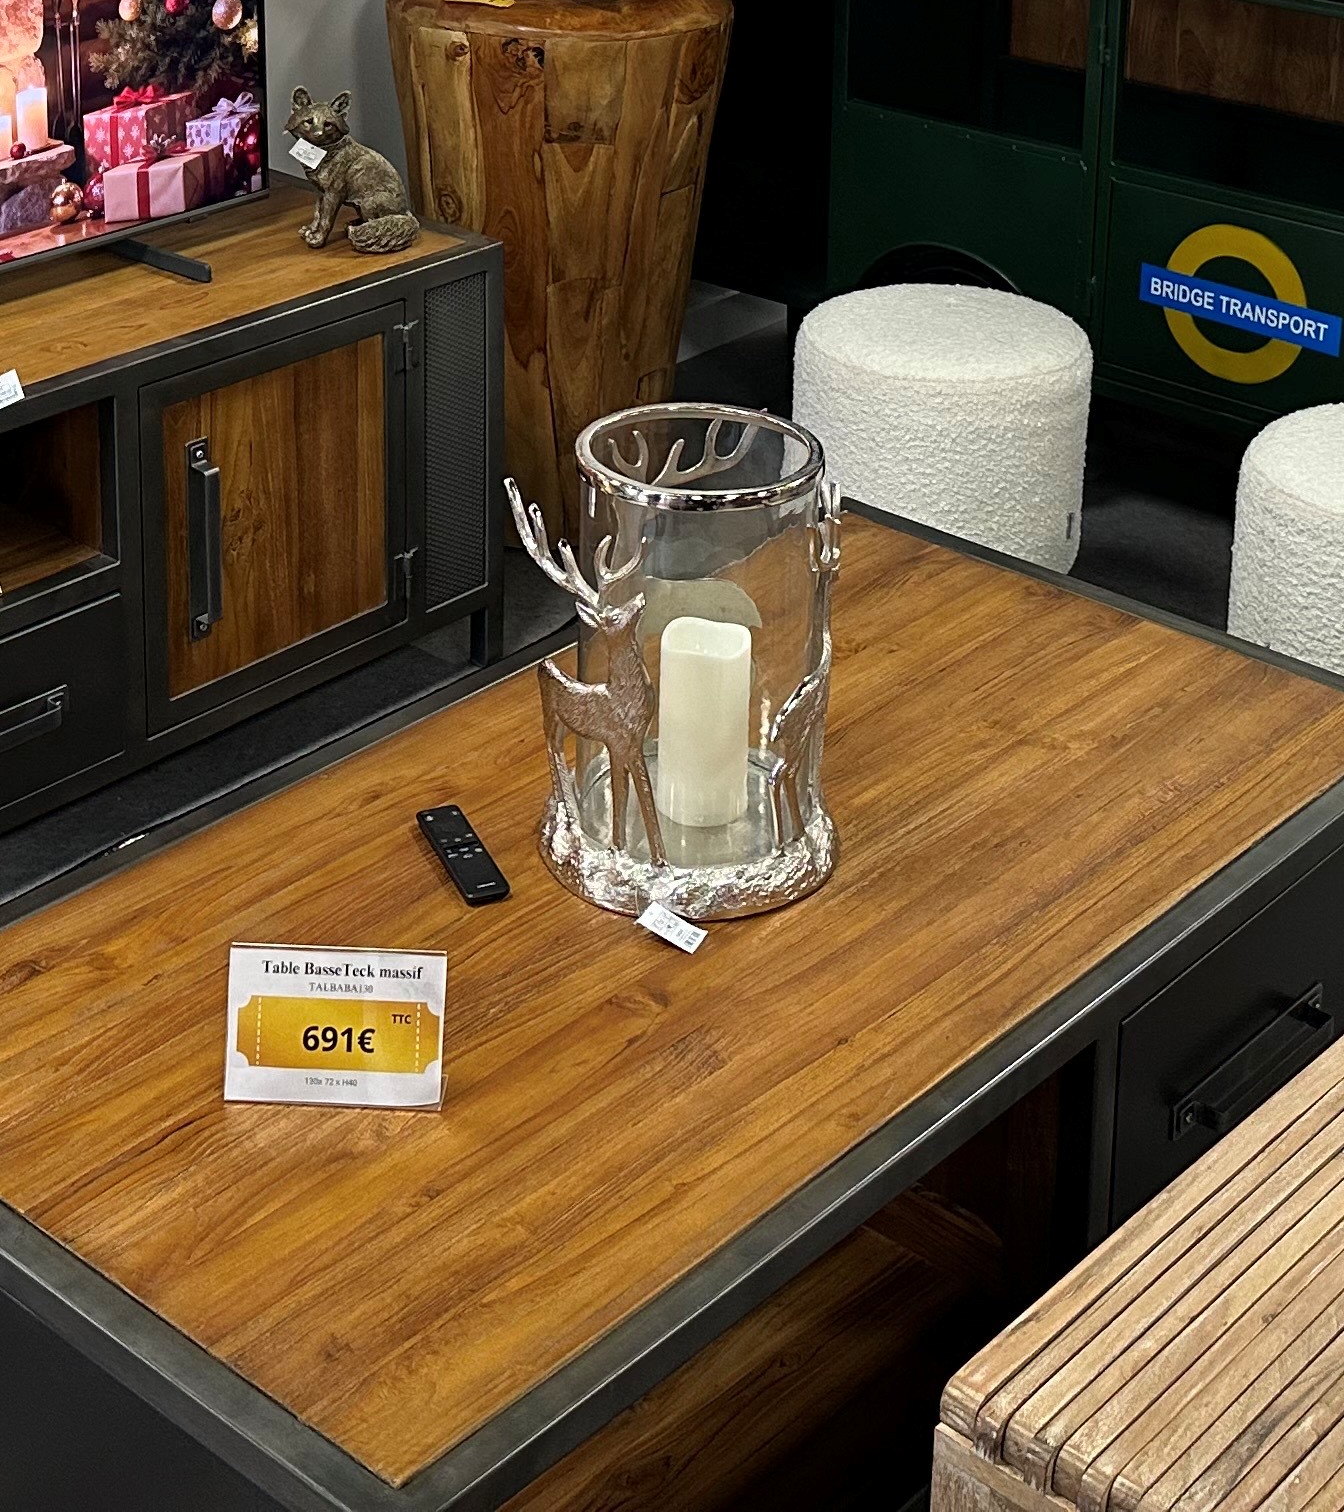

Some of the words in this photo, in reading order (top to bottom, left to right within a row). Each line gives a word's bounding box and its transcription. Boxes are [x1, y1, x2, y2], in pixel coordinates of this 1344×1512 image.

[1150, 276, 1215, 311] BRIDGE
[1219, 294, 1329, 342] TRANSPORT
[262, 960, 301, 975] Table
[379, 966, 423, 980] massif
[392, 1014, 411, 1024] TTC
[302, 1025, 376, 1053] 691€
[325, 1076, 335, 1086] 72
